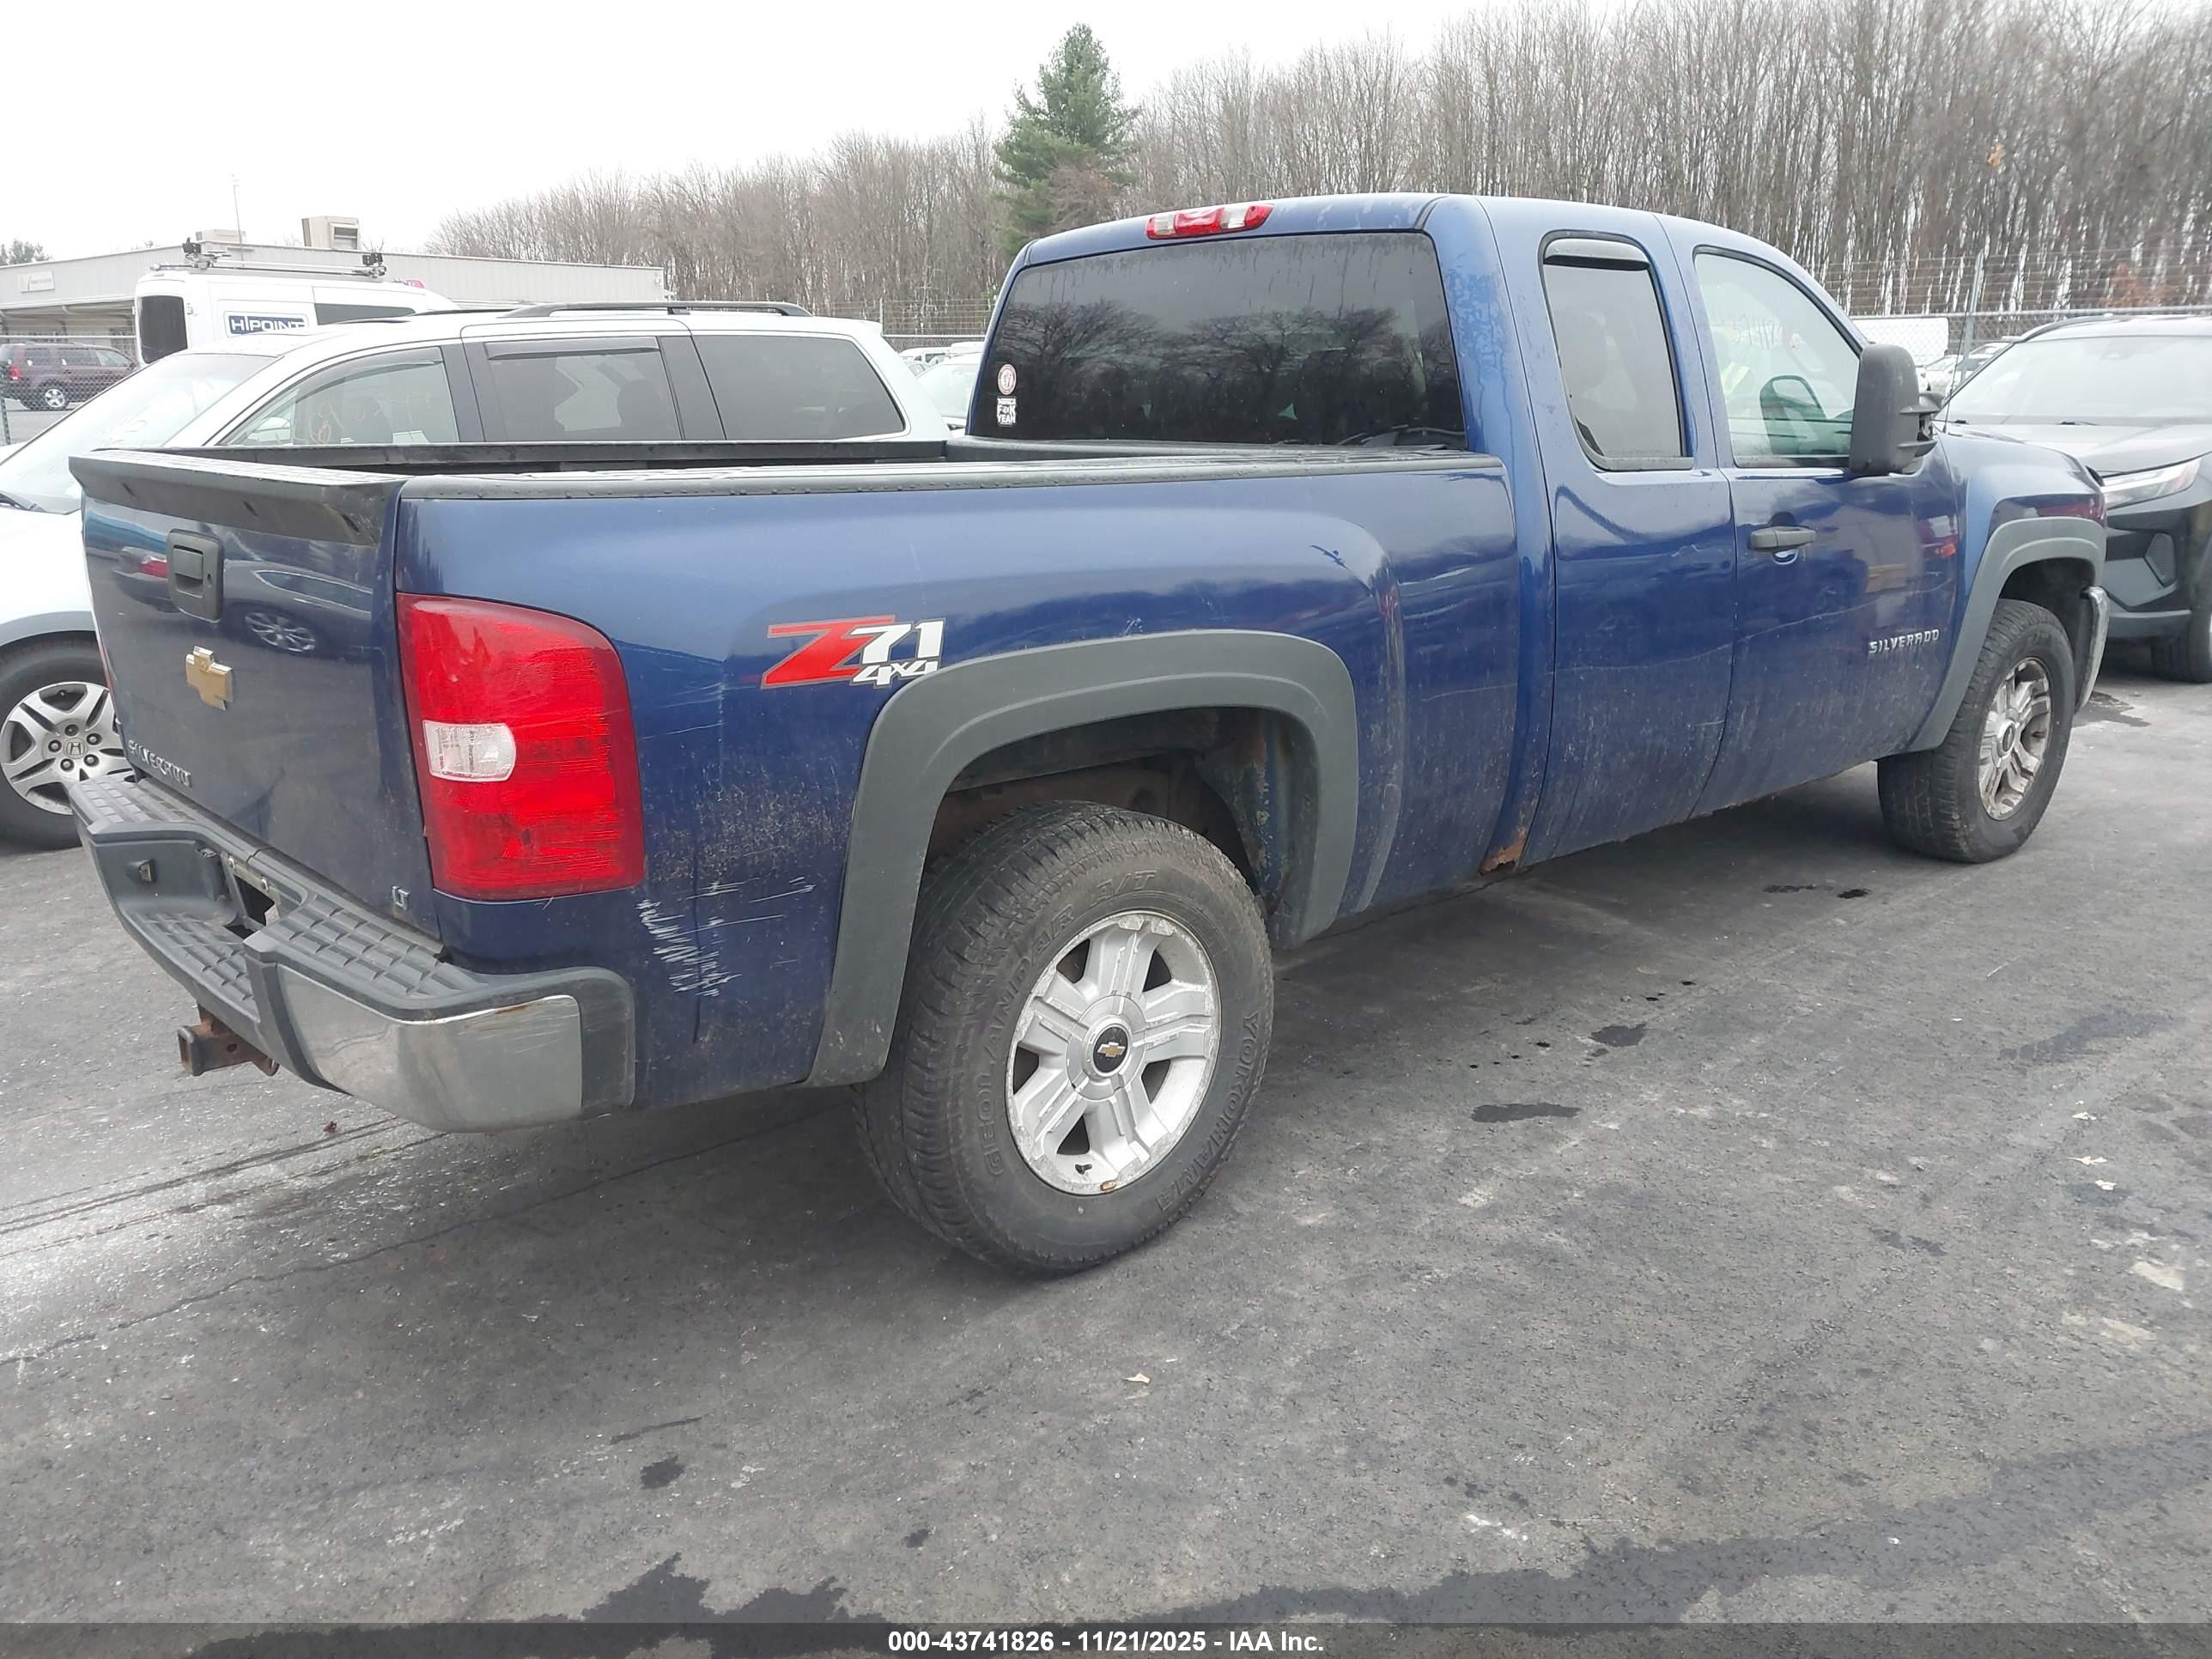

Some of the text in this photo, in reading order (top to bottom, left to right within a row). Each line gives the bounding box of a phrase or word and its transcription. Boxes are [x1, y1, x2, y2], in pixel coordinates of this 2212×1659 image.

[761, 615, 945, 689] Z71
[1869, 629, 1940, 653] SILVERADO
[392, 885, 410, 911] LT
[1156, 1012, 1260, 1212] YOKOHAMA
